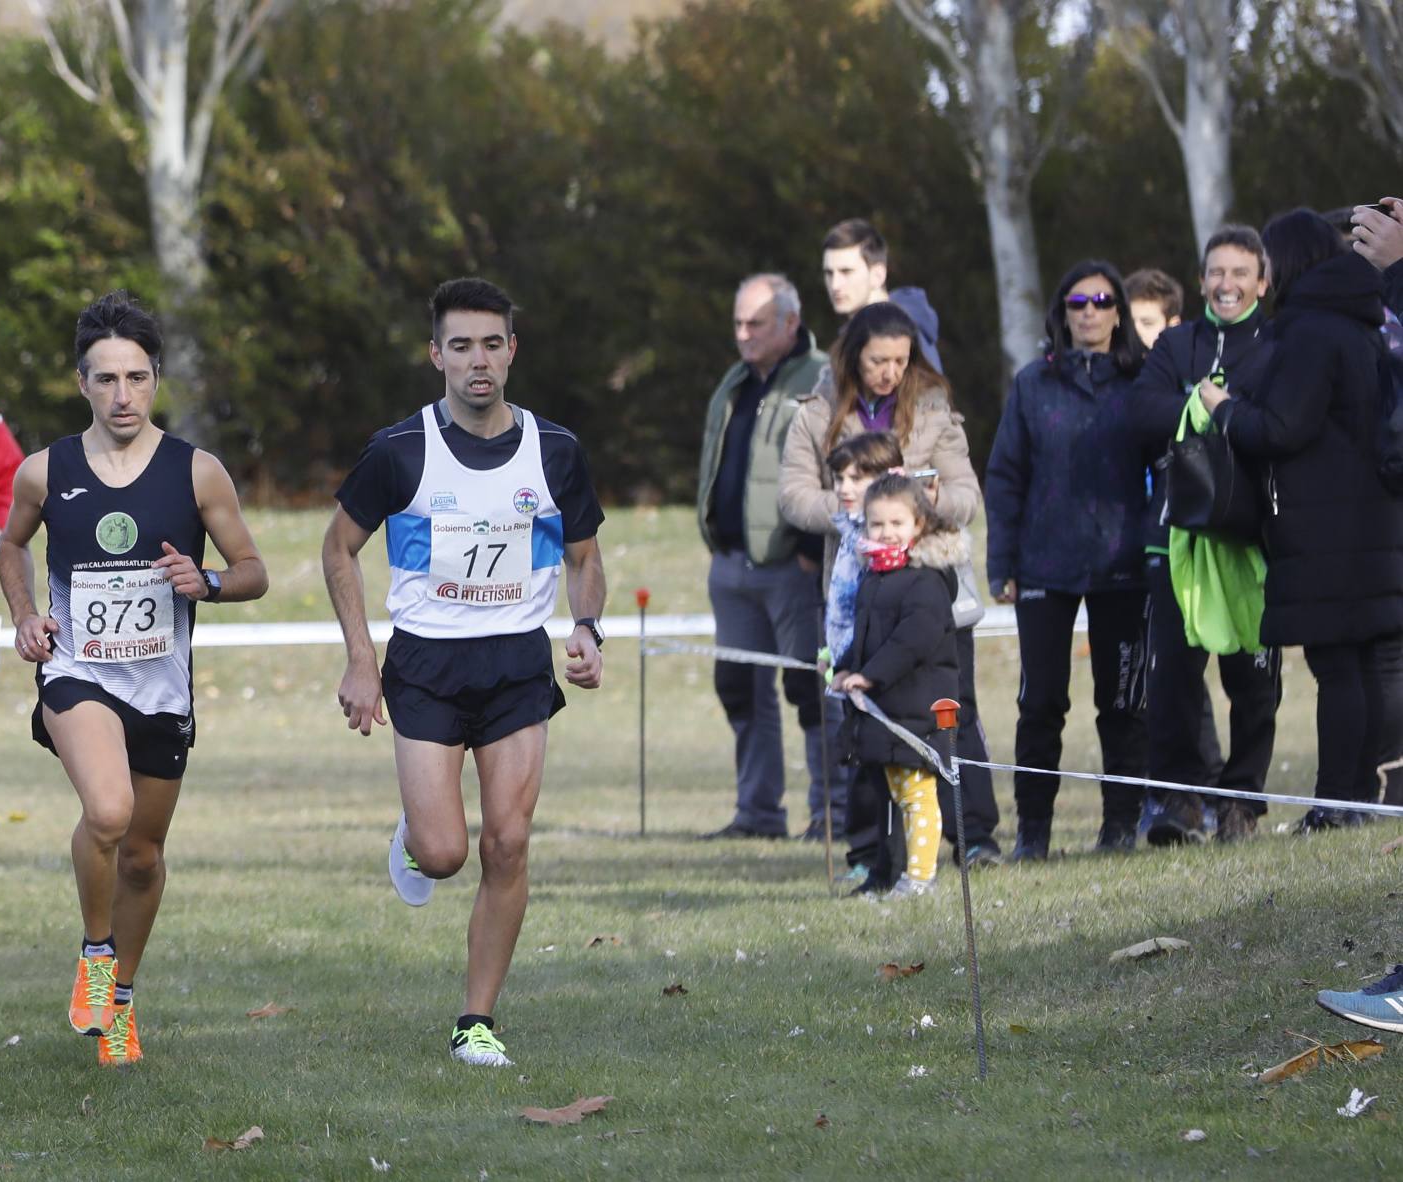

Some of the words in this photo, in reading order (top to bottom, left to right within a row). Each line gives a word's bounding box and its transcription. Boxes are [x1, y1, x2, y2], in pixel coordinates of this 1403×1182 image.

[433, 524, 471, 533] Gobierno
[513, 522, 531, 531] Rioja
[463, 543, 508, 578] 17
[72, 580, 106, 590] Gobierno
[126, 580, 137, 588] de
[138, 579, 149, 588] La
[461, 588, 522, 602] ATLETISMO
[85, 597, 157, 635] 873
[105, 641, 167, 659] ATLETISMO
